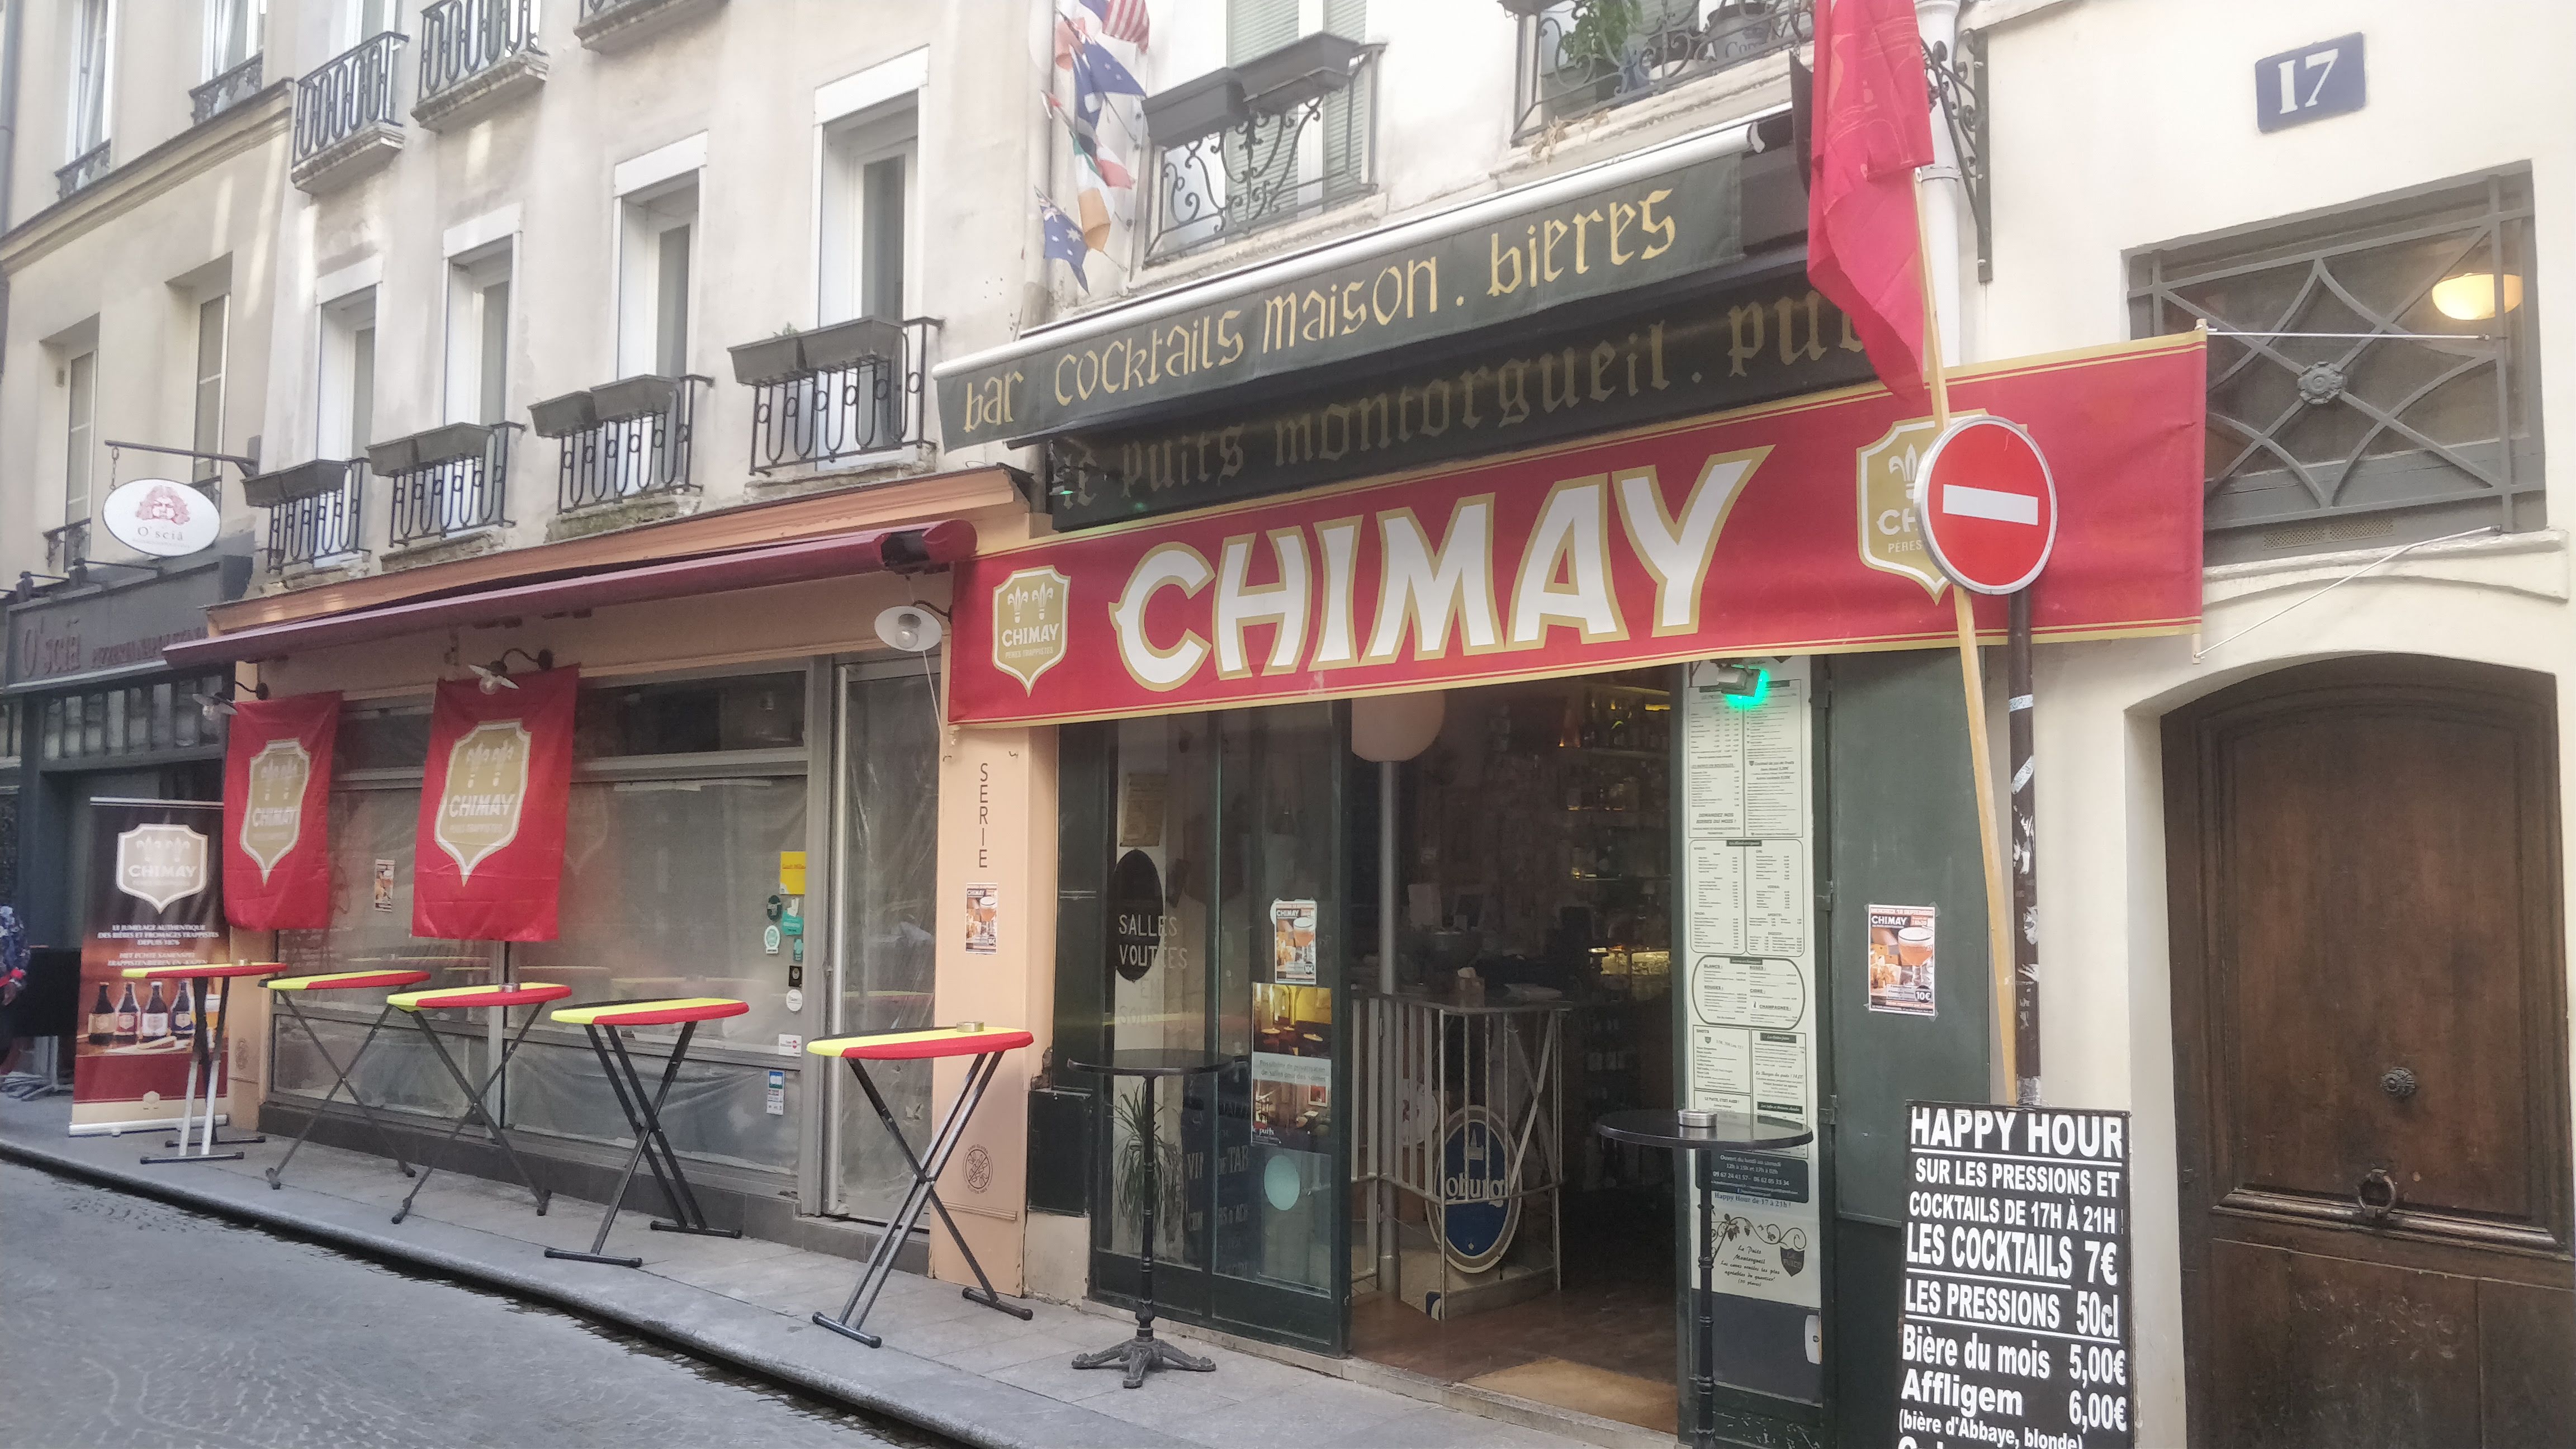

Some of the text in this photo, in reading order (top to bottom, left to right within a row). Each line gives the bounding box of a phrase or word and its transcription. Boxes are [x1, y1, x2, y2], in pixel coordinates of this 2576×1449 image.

[2278, 48, 2338, 115] 17
[964, 371, 1023, 432] bar
[1055, 310, 1243, 406] cocktails
[1486, 188, 1676, 296] bieres
[1121, 423, 1244, 498] puits
[1275, 320, 1670, 466] montorgueil
[1108, 444, 1776, 692] CHIMAY
[1002, 623, 1060, 647] CHIMAY
[449, 794, 515, 817] CHIMAY
[128, 865, 196, 878] CHIMAY
[1119, 915, 1177, 937] SALLES
[1871, 915, 1907, 925] CHIMAY
[1916, 991, 1931, 1001] 10€
[1910, 1106, 2122, 1159] HAPPY HOUR
[1715, 1192, 1734, 1200] Happy
[1915, 1158, 2120, 1197] SUR LES PRESSIONS ET
[1909, 1191, 2000, 1223] COCKTAILS
[2005, 1199, 2026, 1227] DE
[2031, 1201, 2062, 1230] 17H
[2067, 1198, 2079, 1232] À
[2083, 1205, 2115, 1233] 21H
[1746, 1246, 1761, 1254] Puits
[1906, 1221, 2118, 1286] LES COCKTAILS 7€
[1905, 1278, 2119, 1338] LES PRESSIONS 50cl
[1902, 1325, 2126, 1388] Bière du mois 5,00€
[1901, 1368, 2127, 1432] Affligem 6,00€
[1898, 1408, 1942, 1433] (bière
[1945, 1415, 2020, 1448] d'Abbaye,
[2024, 1427, 2083, 1449] blonde)
